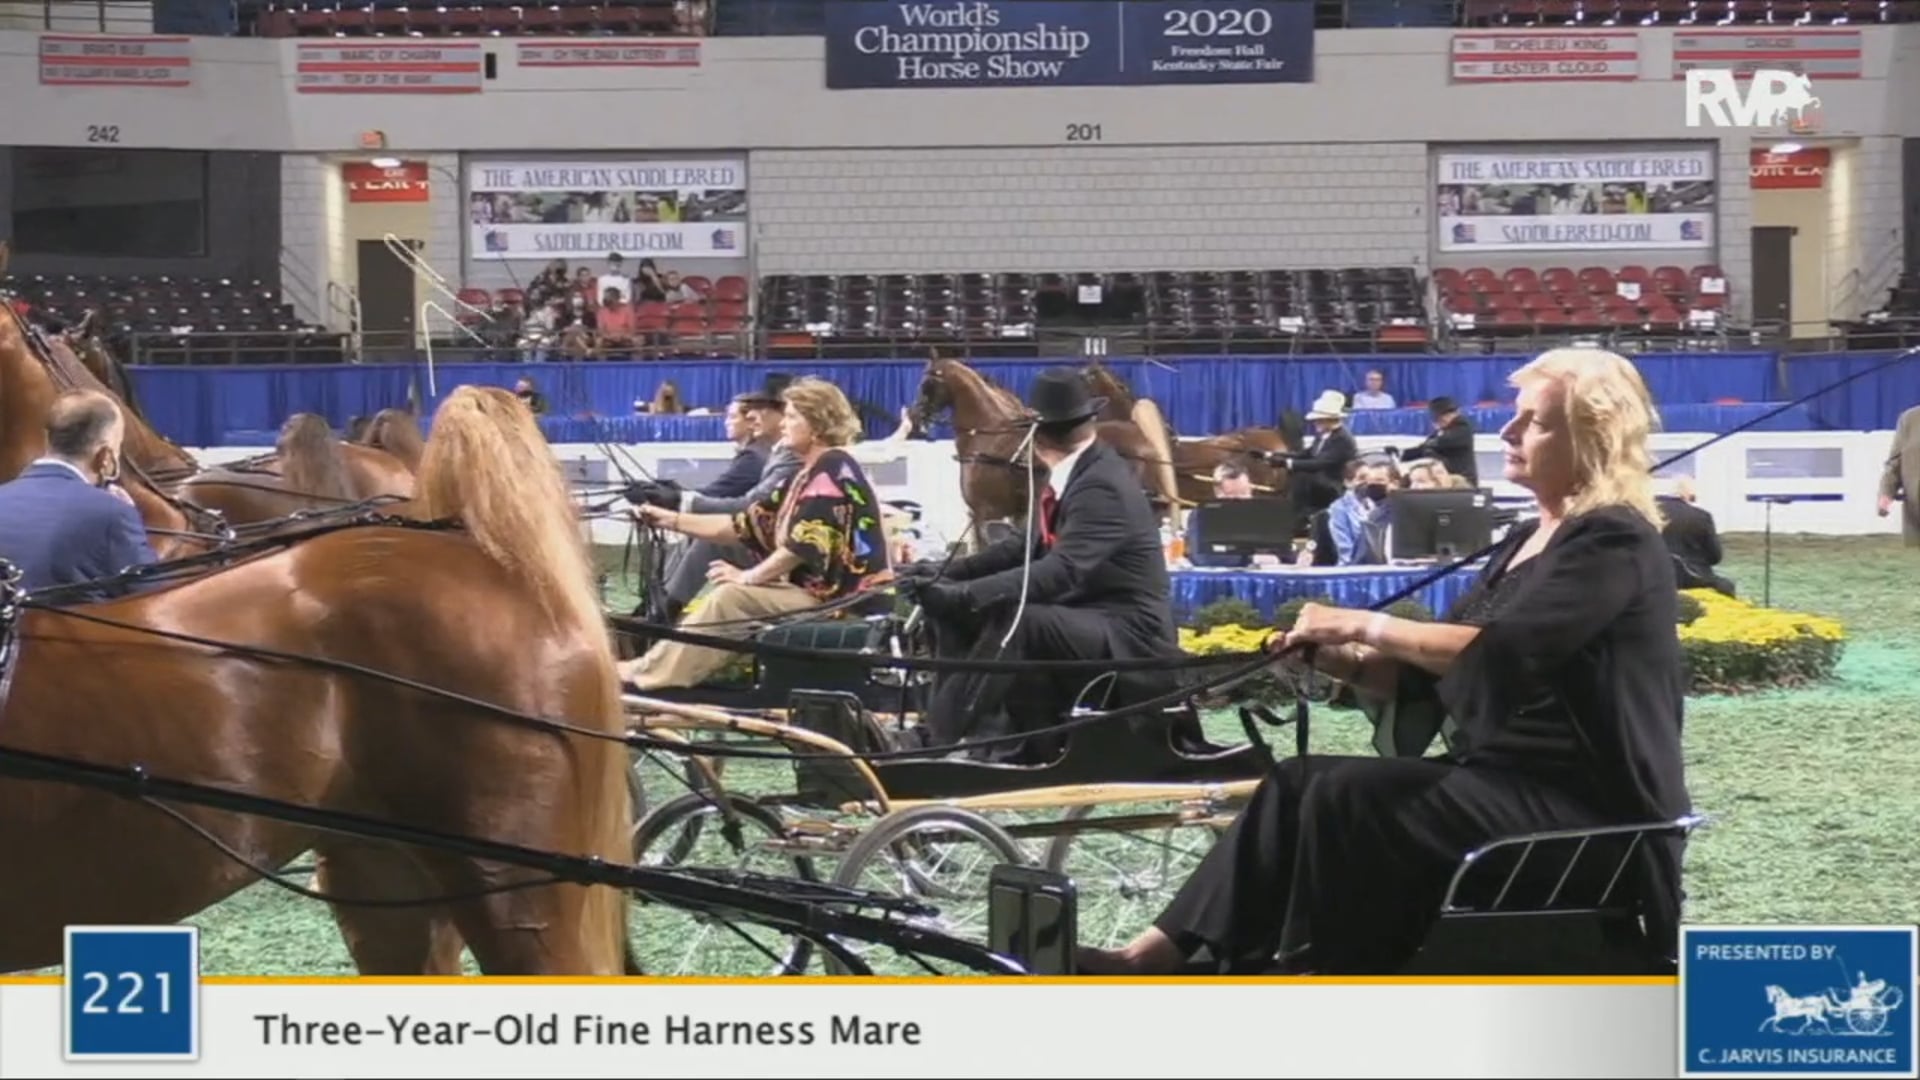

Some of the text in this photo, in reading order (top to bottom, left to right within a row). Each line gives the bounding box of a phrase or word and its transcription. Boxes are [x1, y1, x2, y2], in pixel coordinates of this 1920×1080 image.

[900, 2, 1000, 27] World's
[1163, 8, 1272, 36] 2020
[854, 23, 1090, 58] Championship
[1494, 39, 1608, 51] RICHELIEU KING
[1171, 45, 1264, 57] Freedom Hall
[898, 54, 1064, 80] Horse Show
[1152, 59, 1284, 72] Kentucky State Fair
[1492, 63, 1549, 74] EASTER
[1557, 62, 1608, 74] CLOUD
[87, 124, 119, 142] 242
[1066, 123, 1101, 141] 201
[484, 167, 735, 187] THE AMERICAN SADDLEBRED
[1452, 159, 1703, 179] THE AMERICAN SADDLEBRED
